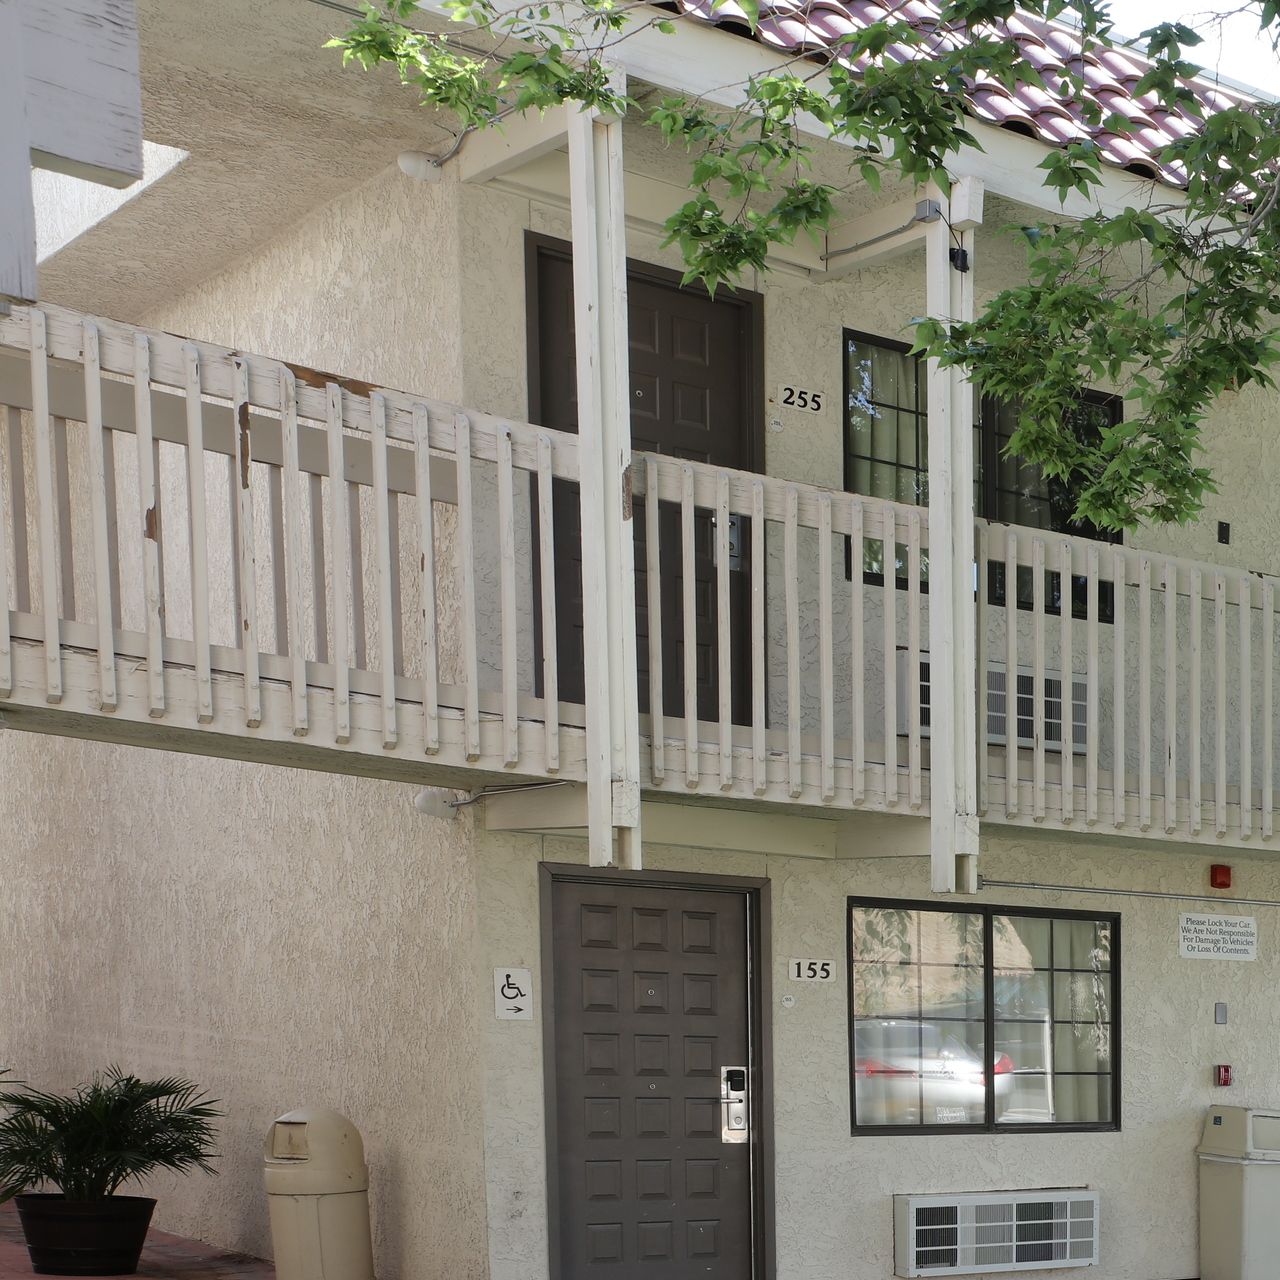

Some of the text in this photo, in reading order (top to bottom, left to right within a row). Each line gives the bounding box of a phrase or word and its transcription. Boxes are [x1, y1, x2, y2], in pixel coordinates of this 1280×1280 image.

[782, 387, 821, 411] 255
[1186, 917, 1207, 926] Please
[1207, 919, 1224, 927] Lock
[1224, 920, 1238, 928] Your
[1181, 926, 1256, 938] We Are Not Responsible
[1183, 935, 1254, 946] For Damage To Vehicles
[1186, 944, 1250, 955] Or Loss Of Contents.
[795, 961, 831, 979] 155
